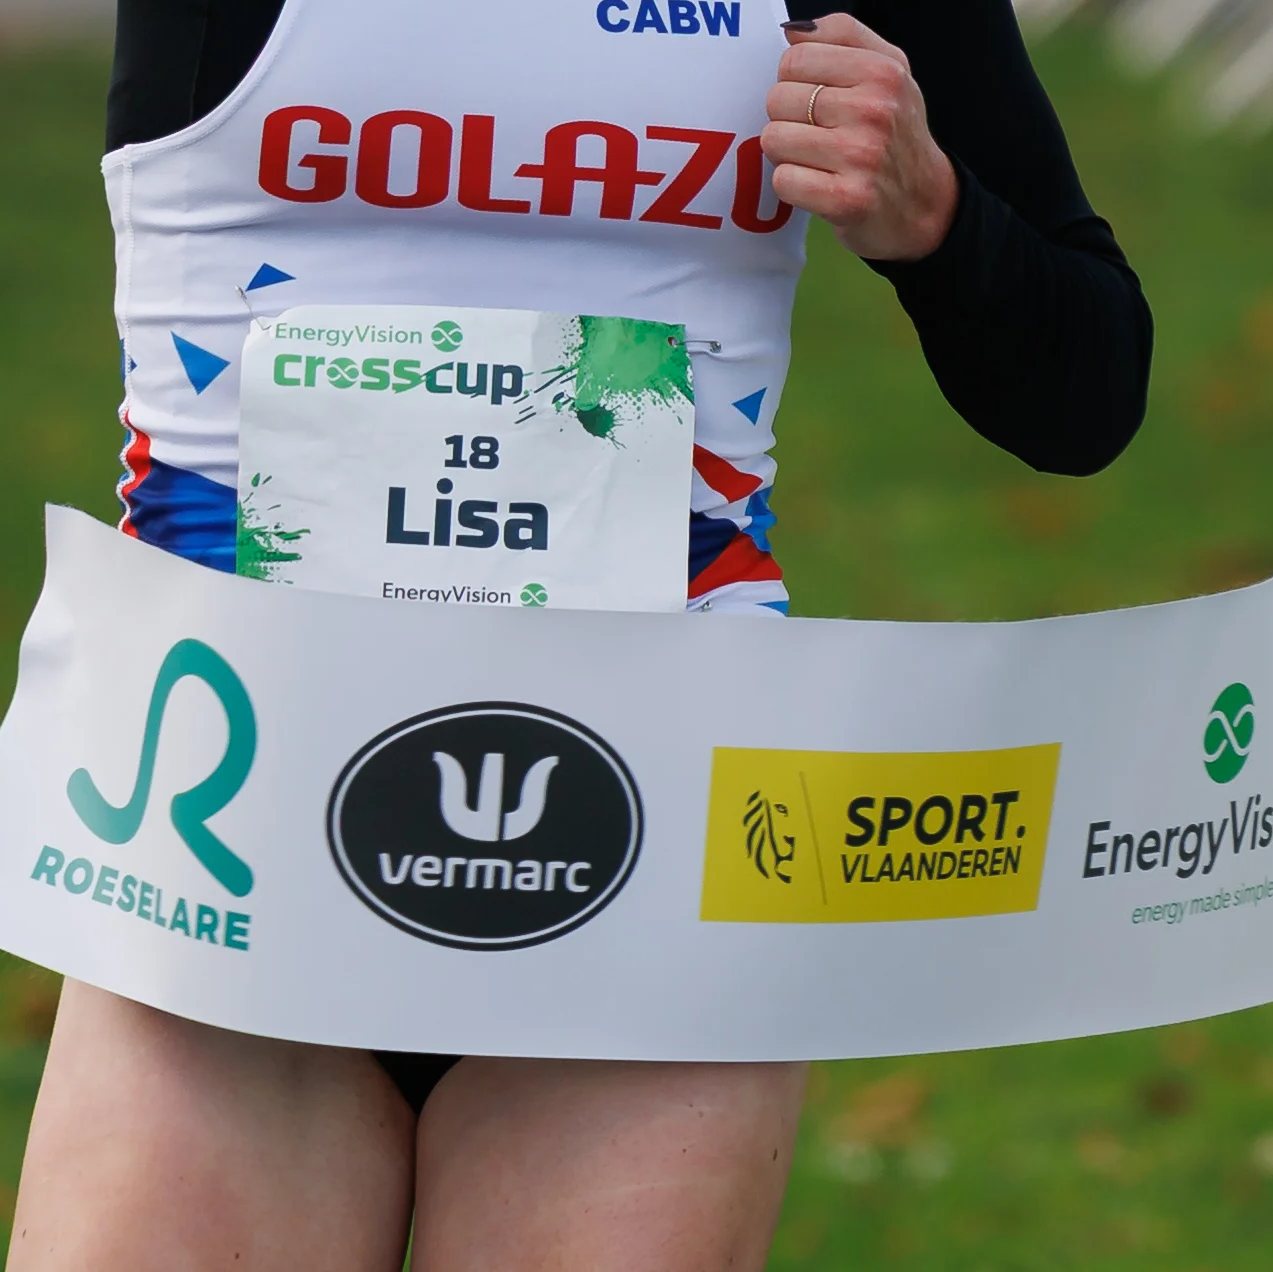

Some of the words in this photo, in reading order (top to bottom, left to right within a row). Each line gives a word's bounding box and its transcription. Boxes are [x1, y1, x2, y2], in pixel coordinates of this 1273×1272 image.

[274, 322, 423, 348] EnergyVision
[443, 434, 501, 470] 18
[385, 478, 549, 551] Lisa
[382, 582, 512, 604] EnergyVision
[844, 790, 1026, 848] SPORT.
[377, 851, 593, 894] vermarc
[840, 844, 1023, 884] VLAANDEREN
[30, 844, 251, 953] ROESELARE
[1131, 899, 1189, 925] energy
[1189, 887, 1231, 916] made
